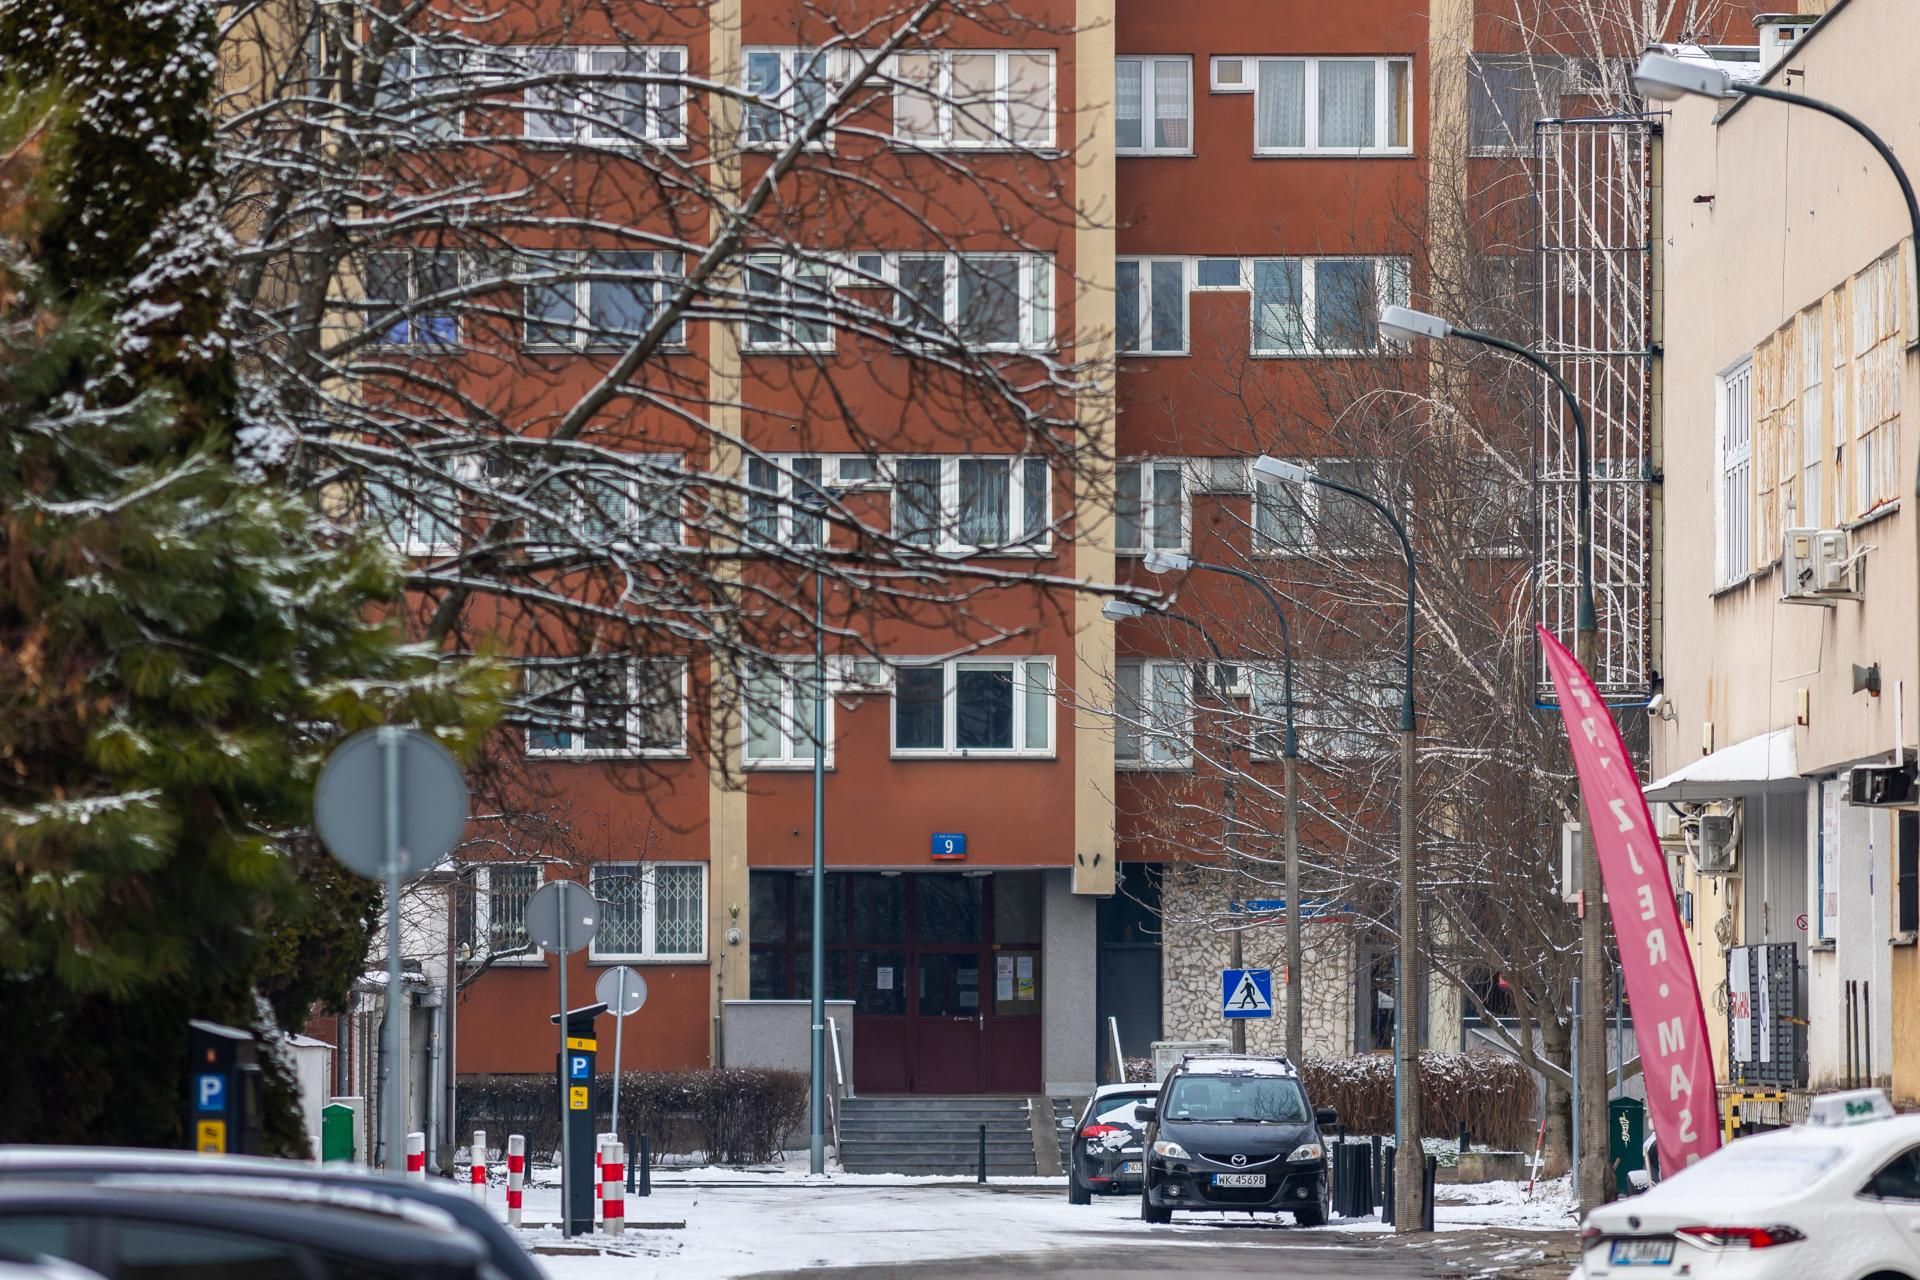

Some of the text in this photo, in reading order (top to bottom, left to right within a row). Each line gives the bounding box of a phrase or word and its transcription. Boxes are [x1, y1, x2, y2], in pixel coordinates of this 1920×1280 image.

[945, 839, 953, 854] 9
[572, 1057, 587, 1075] P
[200, 1075, 222, 1106] P
[1218, 1175, 1265, 1185] WK 45698
